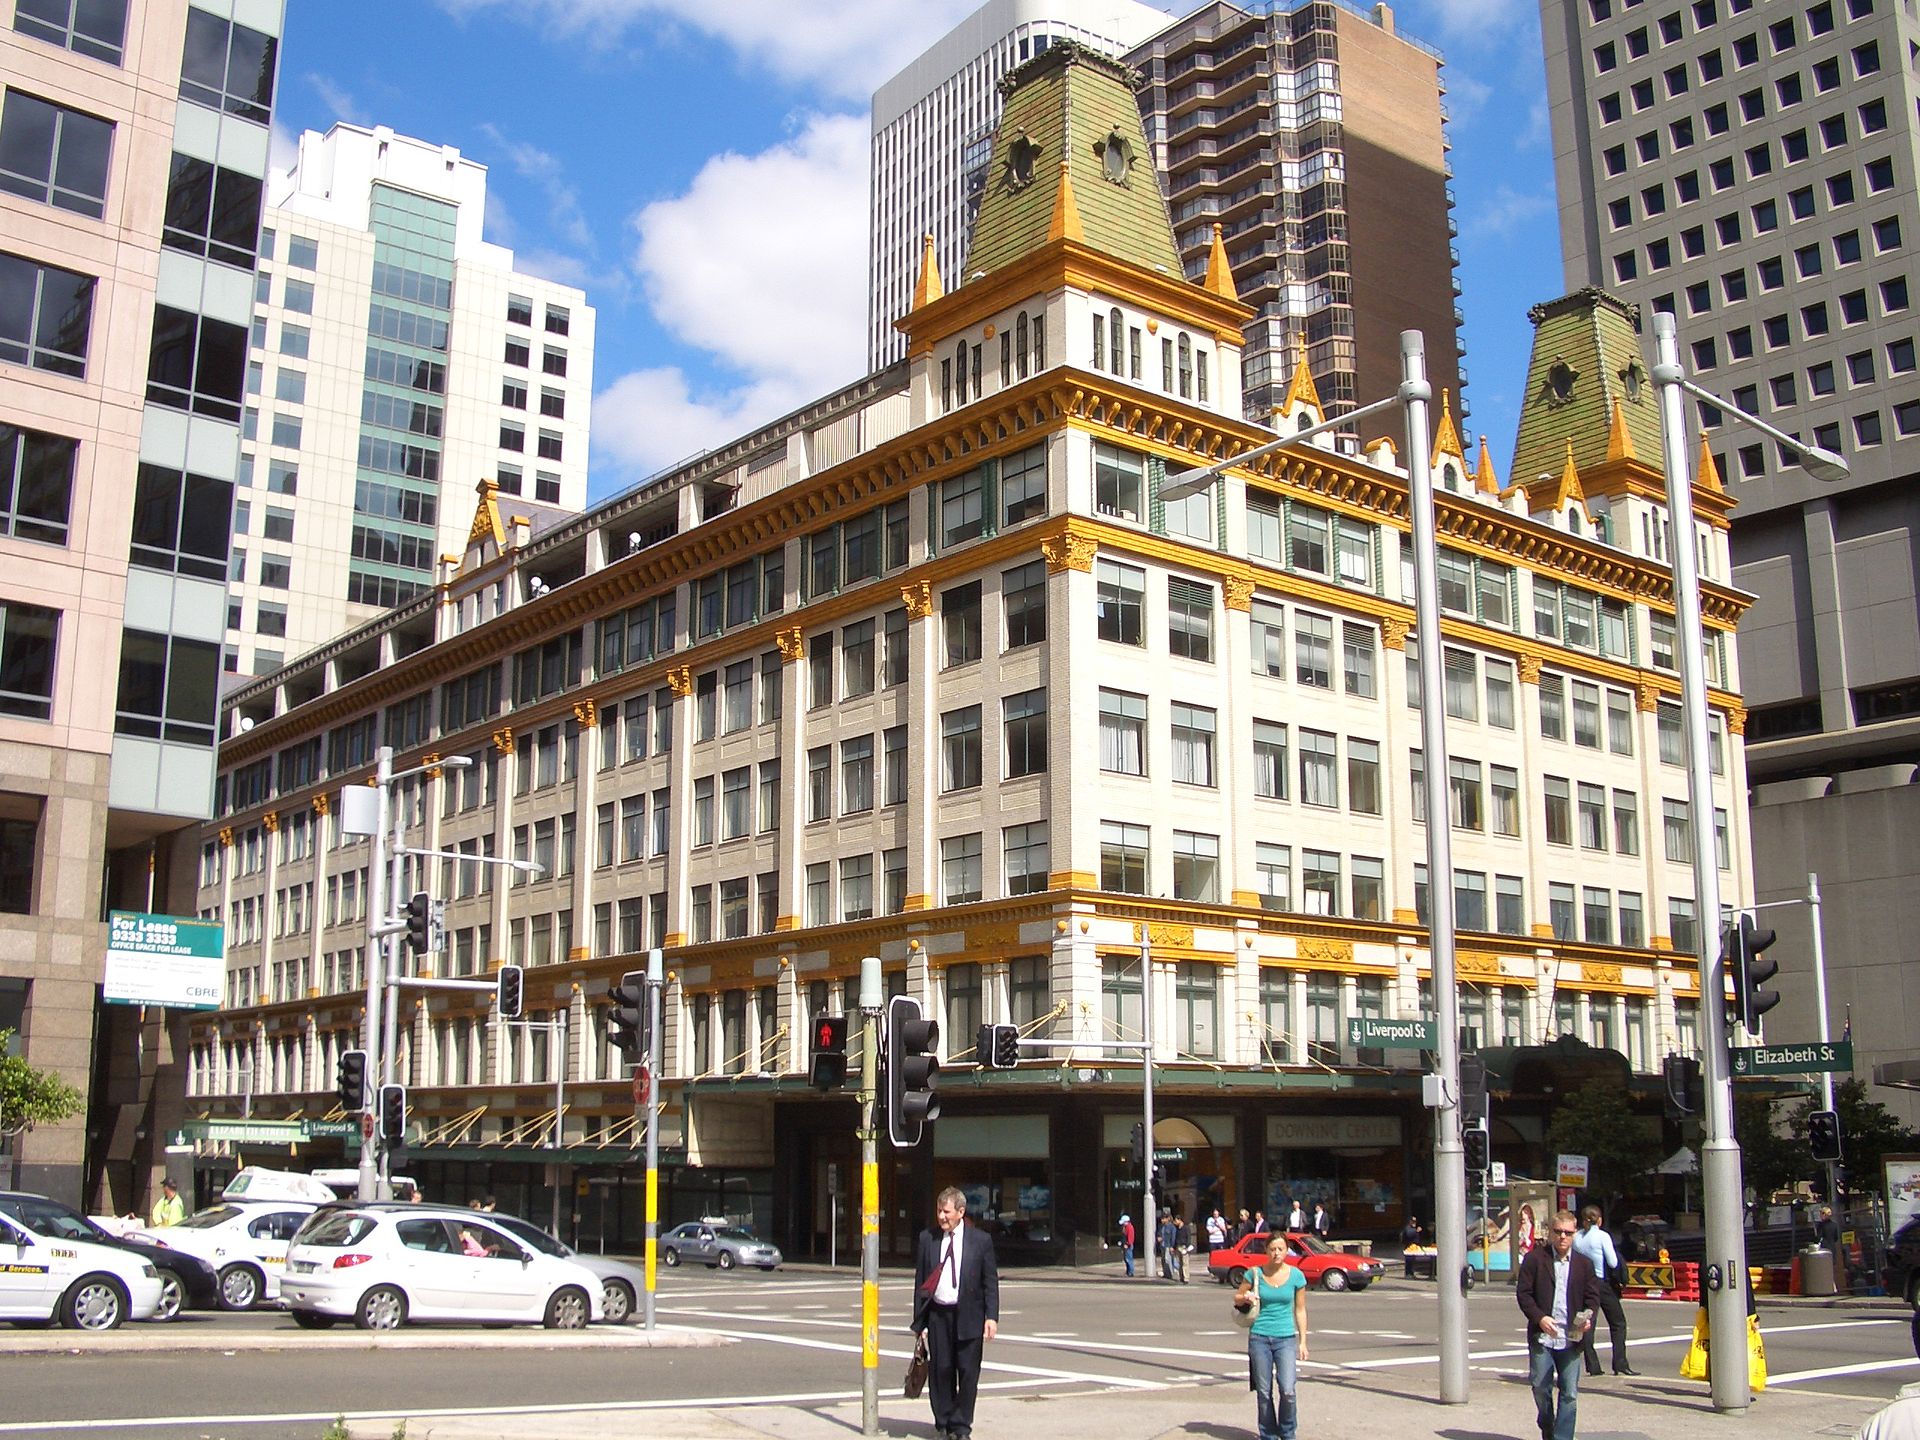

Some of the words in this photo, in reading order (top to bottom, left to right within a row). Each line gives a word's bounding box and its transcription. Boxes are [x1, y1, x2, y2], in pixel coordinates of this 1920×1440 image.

[112, 917, 136, 930] For
[138, 919, 177, 934] Lease
[145, 933, 177, 945] 3333
[111, 941, 135, 950] OFFICE
[136, 943, 156, 952] SPACE
[157, 945, 170, 953] FOR
[171, 946, 192, 955] LEASE
[186, 986, 218, 998] CBRE
[1366, 1021, 1413, 1041] Liverpool
[1414, 1023, 1426, 1039] St
[1755, 1047, 1817, 1064] Elizabeth
[1820, 1045, 1835, 1061] St
[313, 1122, 346, 1132] Liverpool
[347, 1122, 355, 1132] St
[1275, 1123, 1339, 1139] DOWNING
